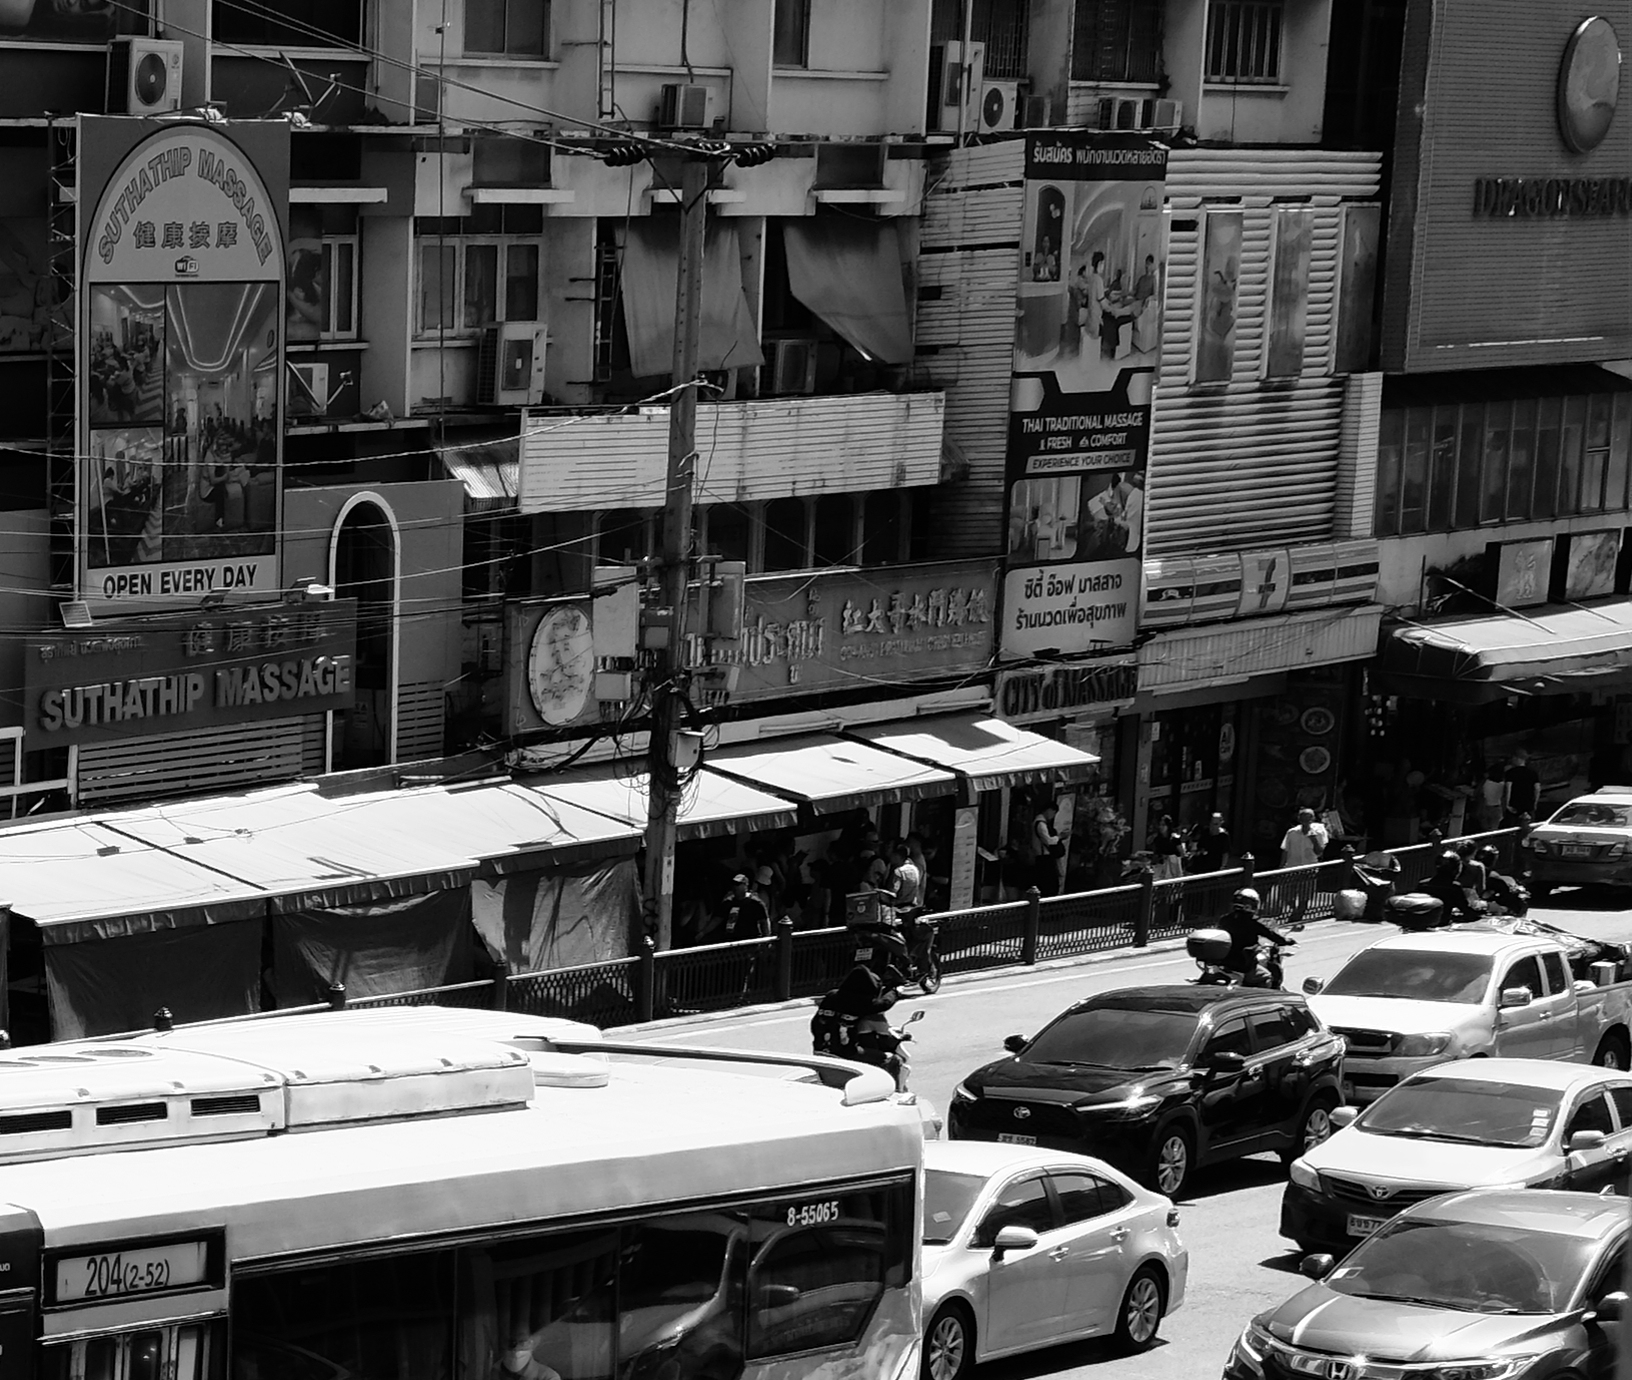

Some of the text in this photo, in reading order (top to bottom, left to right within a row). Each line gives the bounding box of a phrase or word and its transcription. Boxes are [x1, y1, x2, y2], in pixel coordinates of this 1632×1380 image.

[98, 146, 273, 266] SUTHATHIP MASSAGE
[133, 221, 238, 249] 健康按摩
[1022, 412, 1144, 433] THAI TRADITIONAL MASSAGE
[1047, 432, 1128, 450] FRESH COMFORT
[103, 563, 258, 600] OPEN EVERY DAY
[41, 655, 351, 731] SUTHATHIP MASSAGE
[787, 1200, 840, 1227] 8-55065
